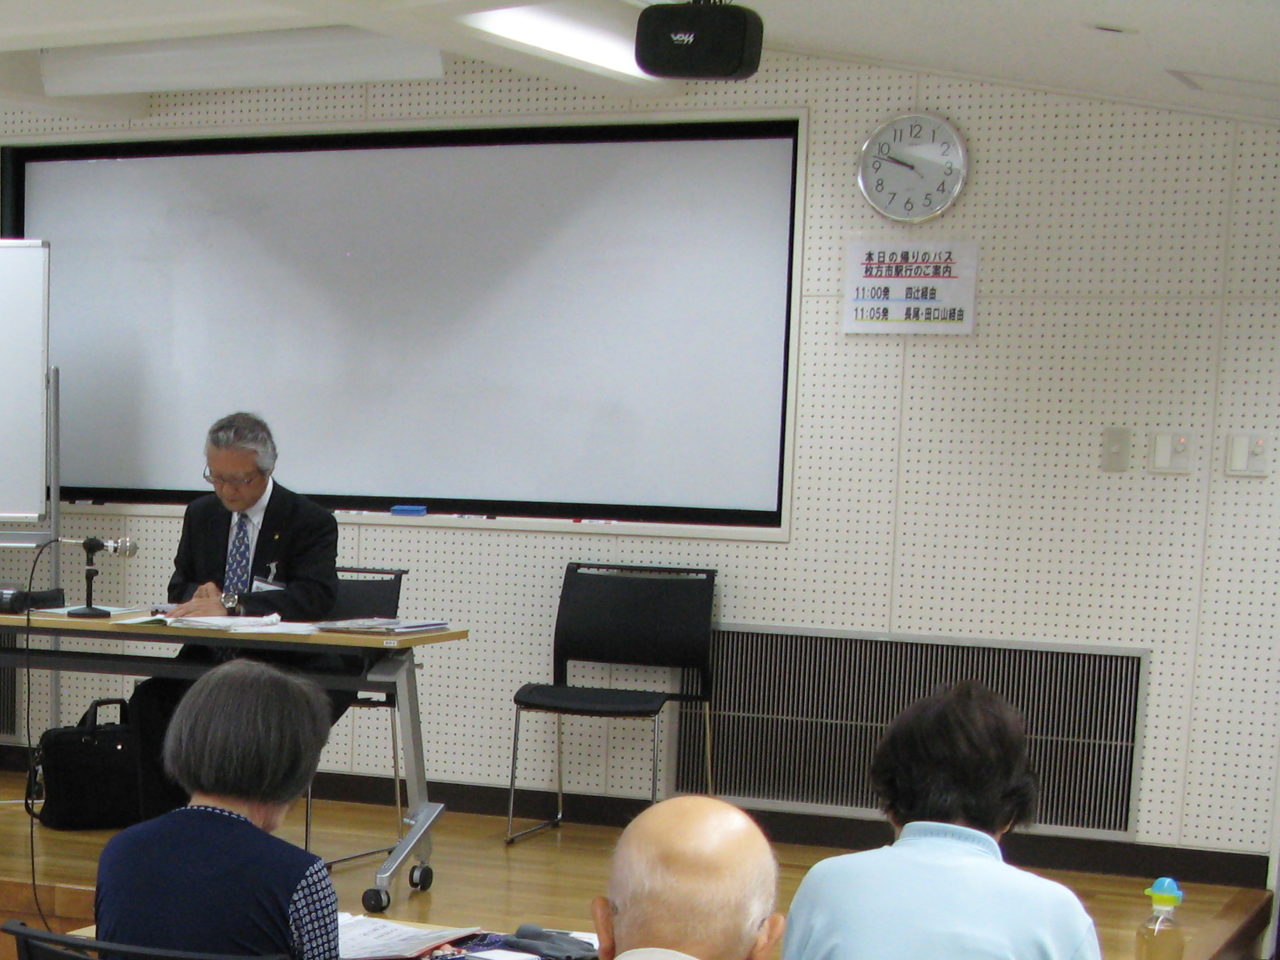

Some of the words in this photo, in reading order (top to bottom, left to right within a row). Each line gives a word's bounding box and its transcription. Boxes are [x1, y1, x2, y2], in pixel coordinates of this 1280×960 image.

[893, 129, 903, 143] 11
[909, 124, 922, 139] 12
[878, 142, 891, 156] 10
[940, 142, 950, 156] 2
[872, 161, 881, 174] 9
[944, 161, 953, 176] 3
[875, 179, 884, 192] 8
[936, 179, 945, 194] 4
[888, 192, 897, 205] 7
[904, 197, 913, 211] 6
[923, 193, 932, 207] 5
[865, 251, 953, 263] 本日の帰りのバス
[864, 265, 952, 277] 枚方市駅行のご案内
[855, 286, 890, 300] 11:00発
[854, 307, 889, 320] 11:05発
